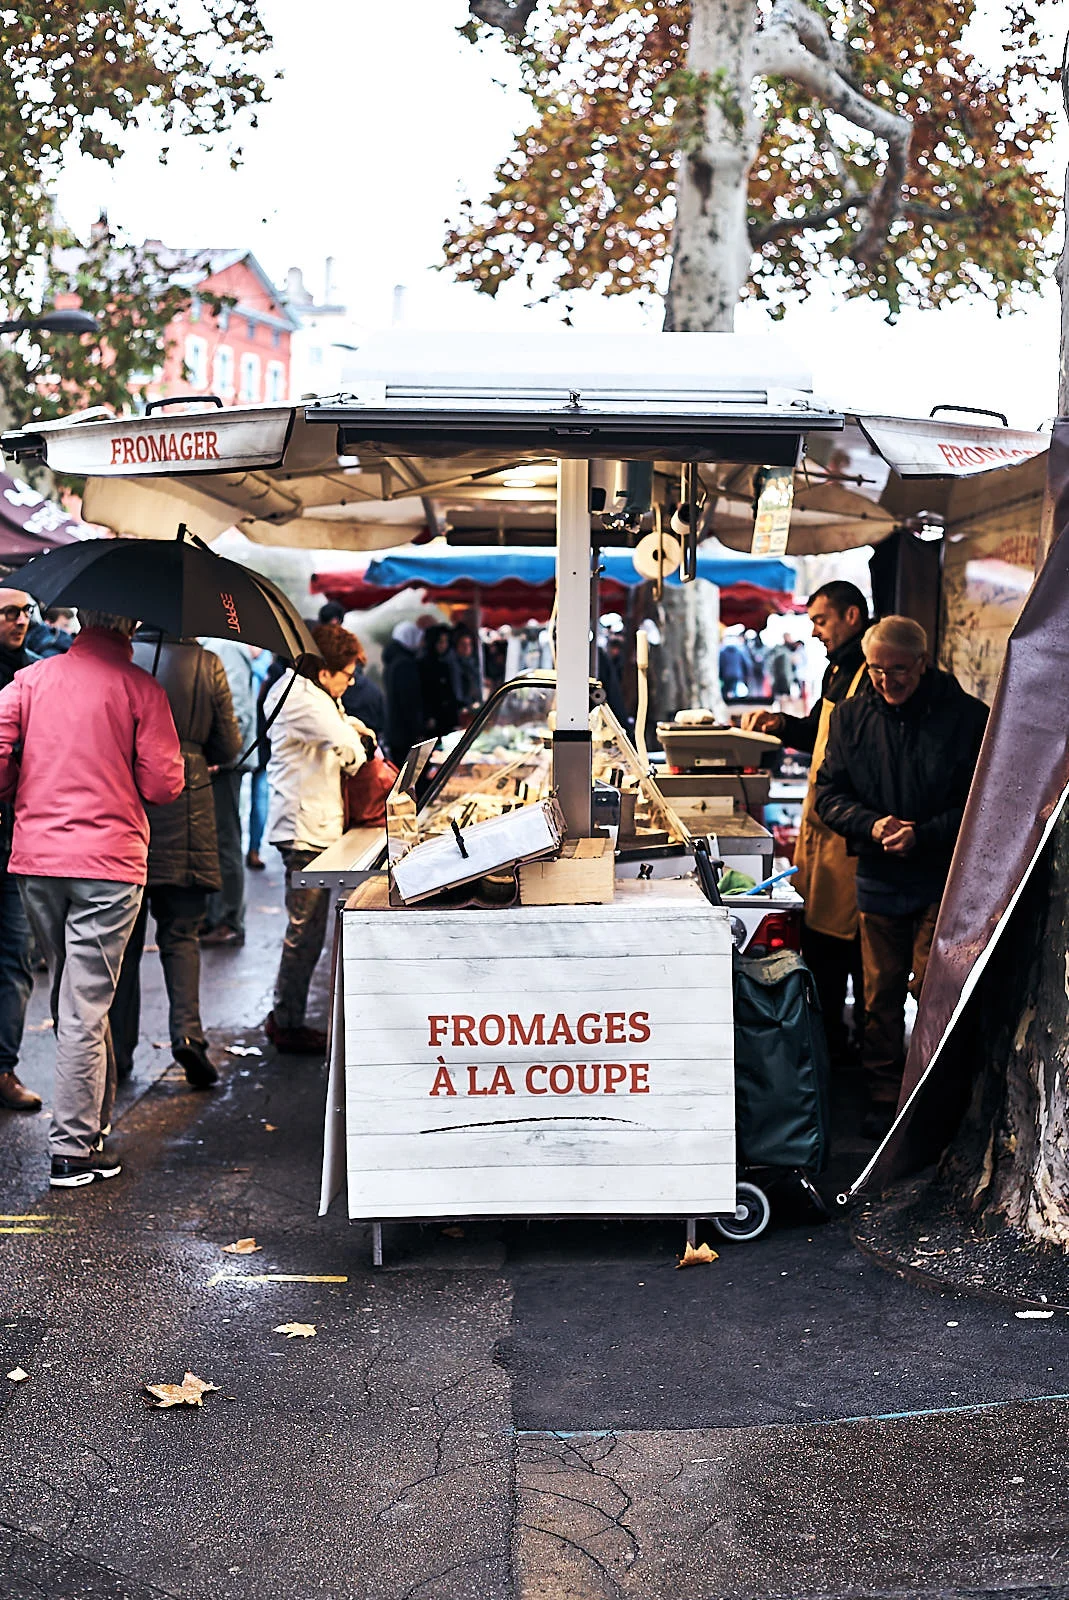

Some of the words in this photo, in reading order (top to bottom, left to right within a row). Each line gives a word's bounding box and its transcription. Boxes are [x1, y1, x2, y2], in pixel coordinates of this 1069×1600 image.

[110, 431, 220, 464] FROMAGER
[220, 592, 241, 634] ESPRIT
[428, 1011, 651, 1046] FROMAGES
[429, 1055, 457, 1096] À
[466, 1065, 516, 1095] LA
[525, 1063, 650, 1094] COUPE
